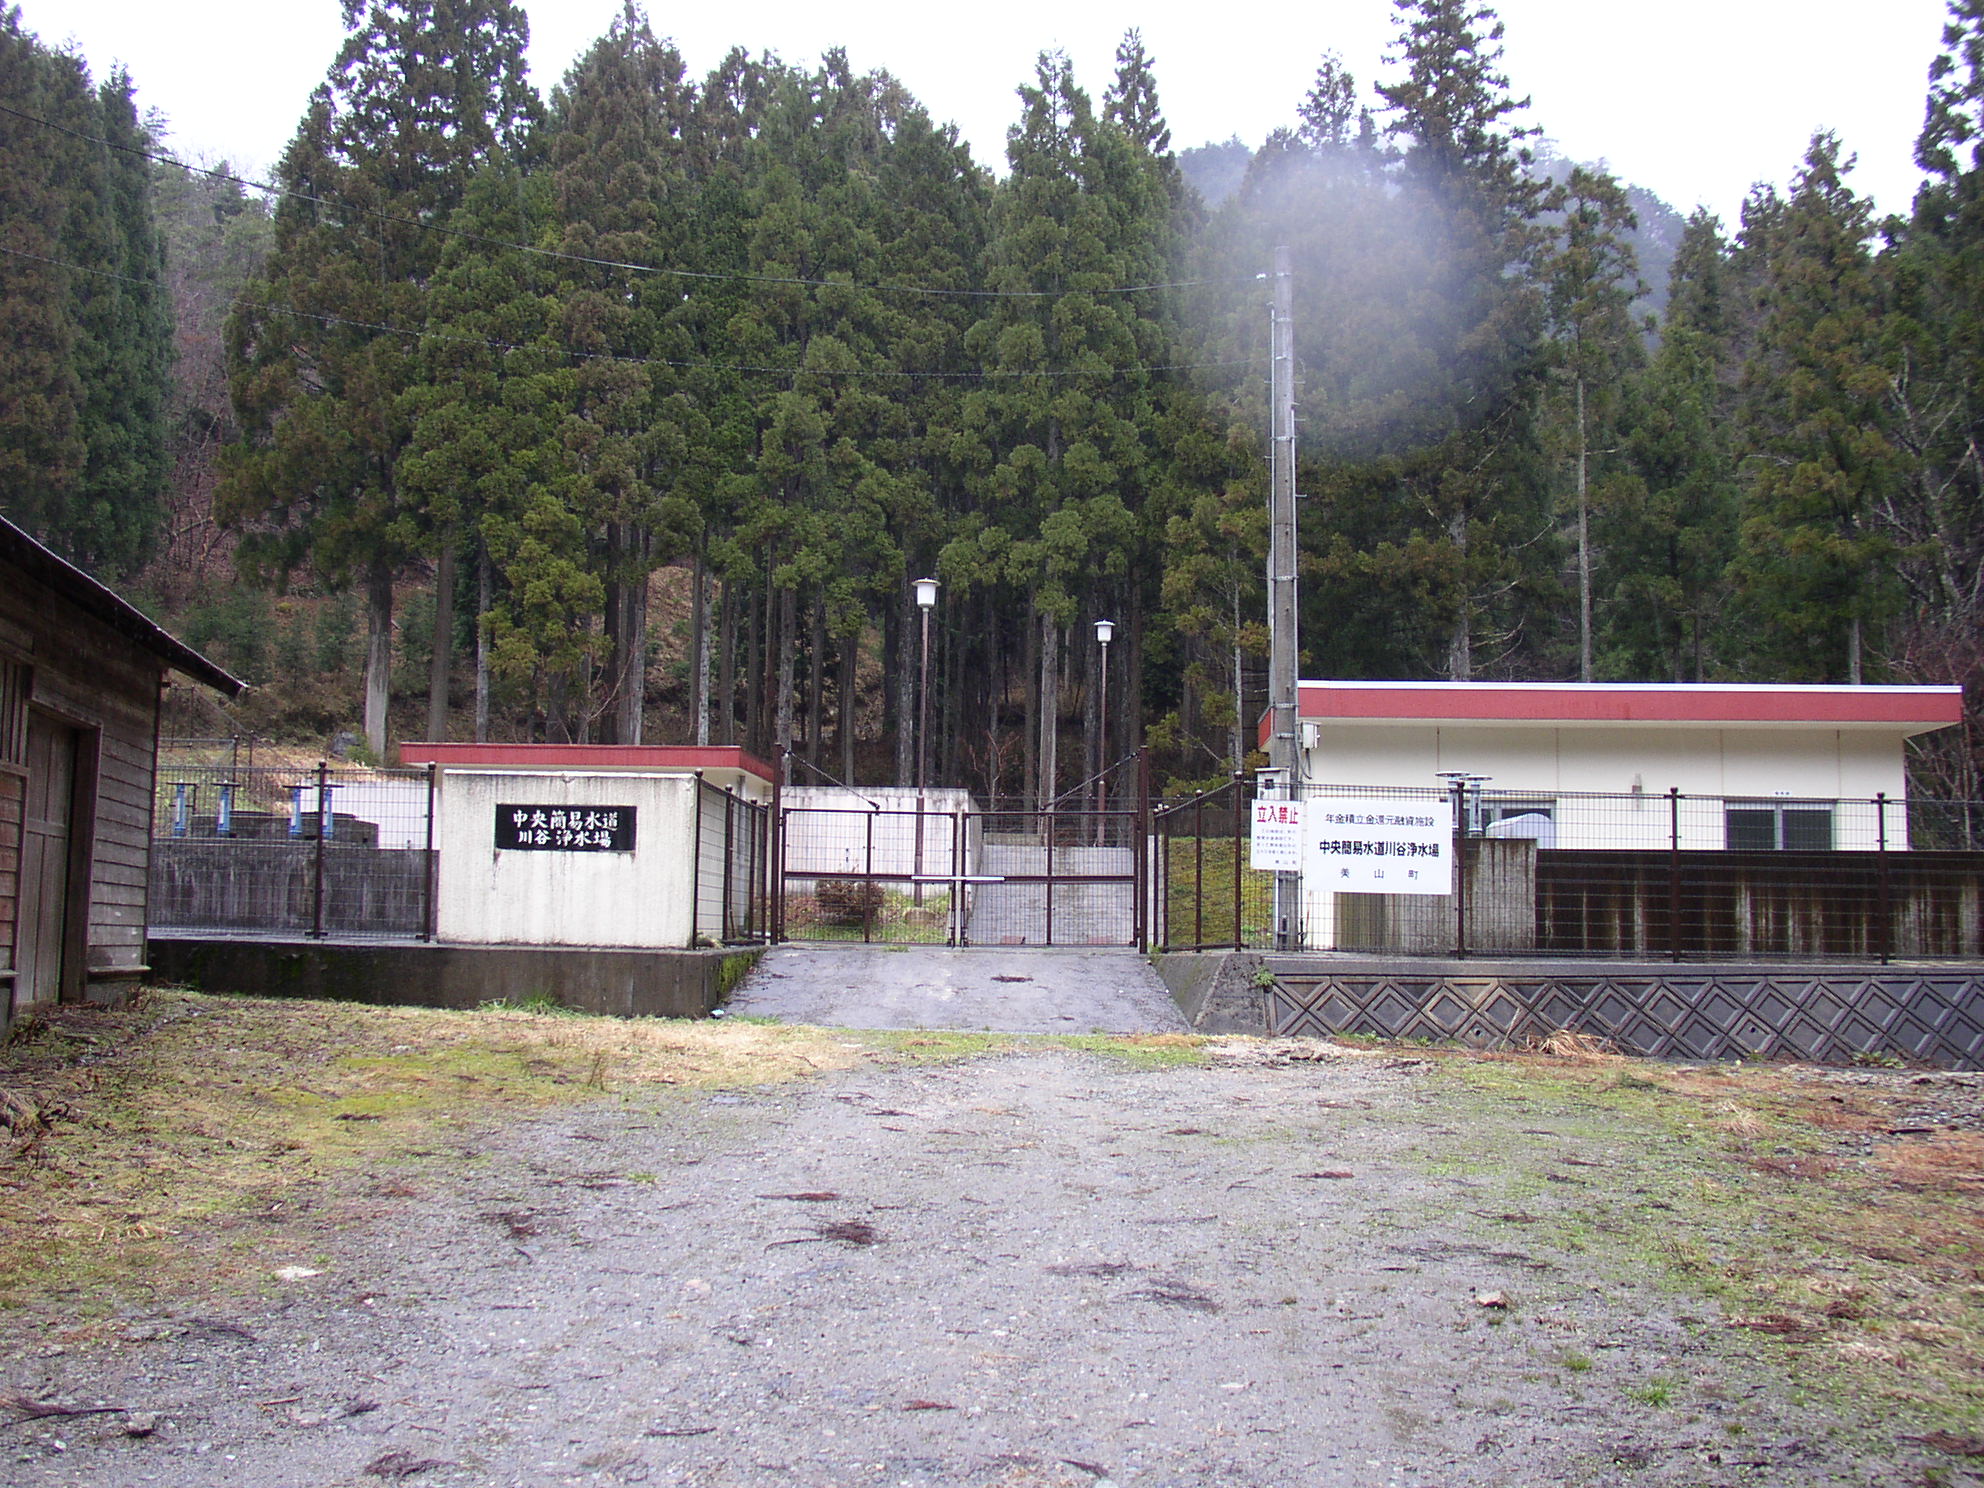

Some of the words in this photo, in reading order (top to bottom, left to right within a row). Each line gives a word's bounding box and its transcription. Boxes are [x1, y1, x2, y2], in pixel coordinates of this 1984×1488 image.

[513, 809, 618, 831] 中央簡易水道
[1257, 805, 1299, 824] 立入禁止
[1319, 839, 1440, 857] 中央簡易水道川谷浄水場
